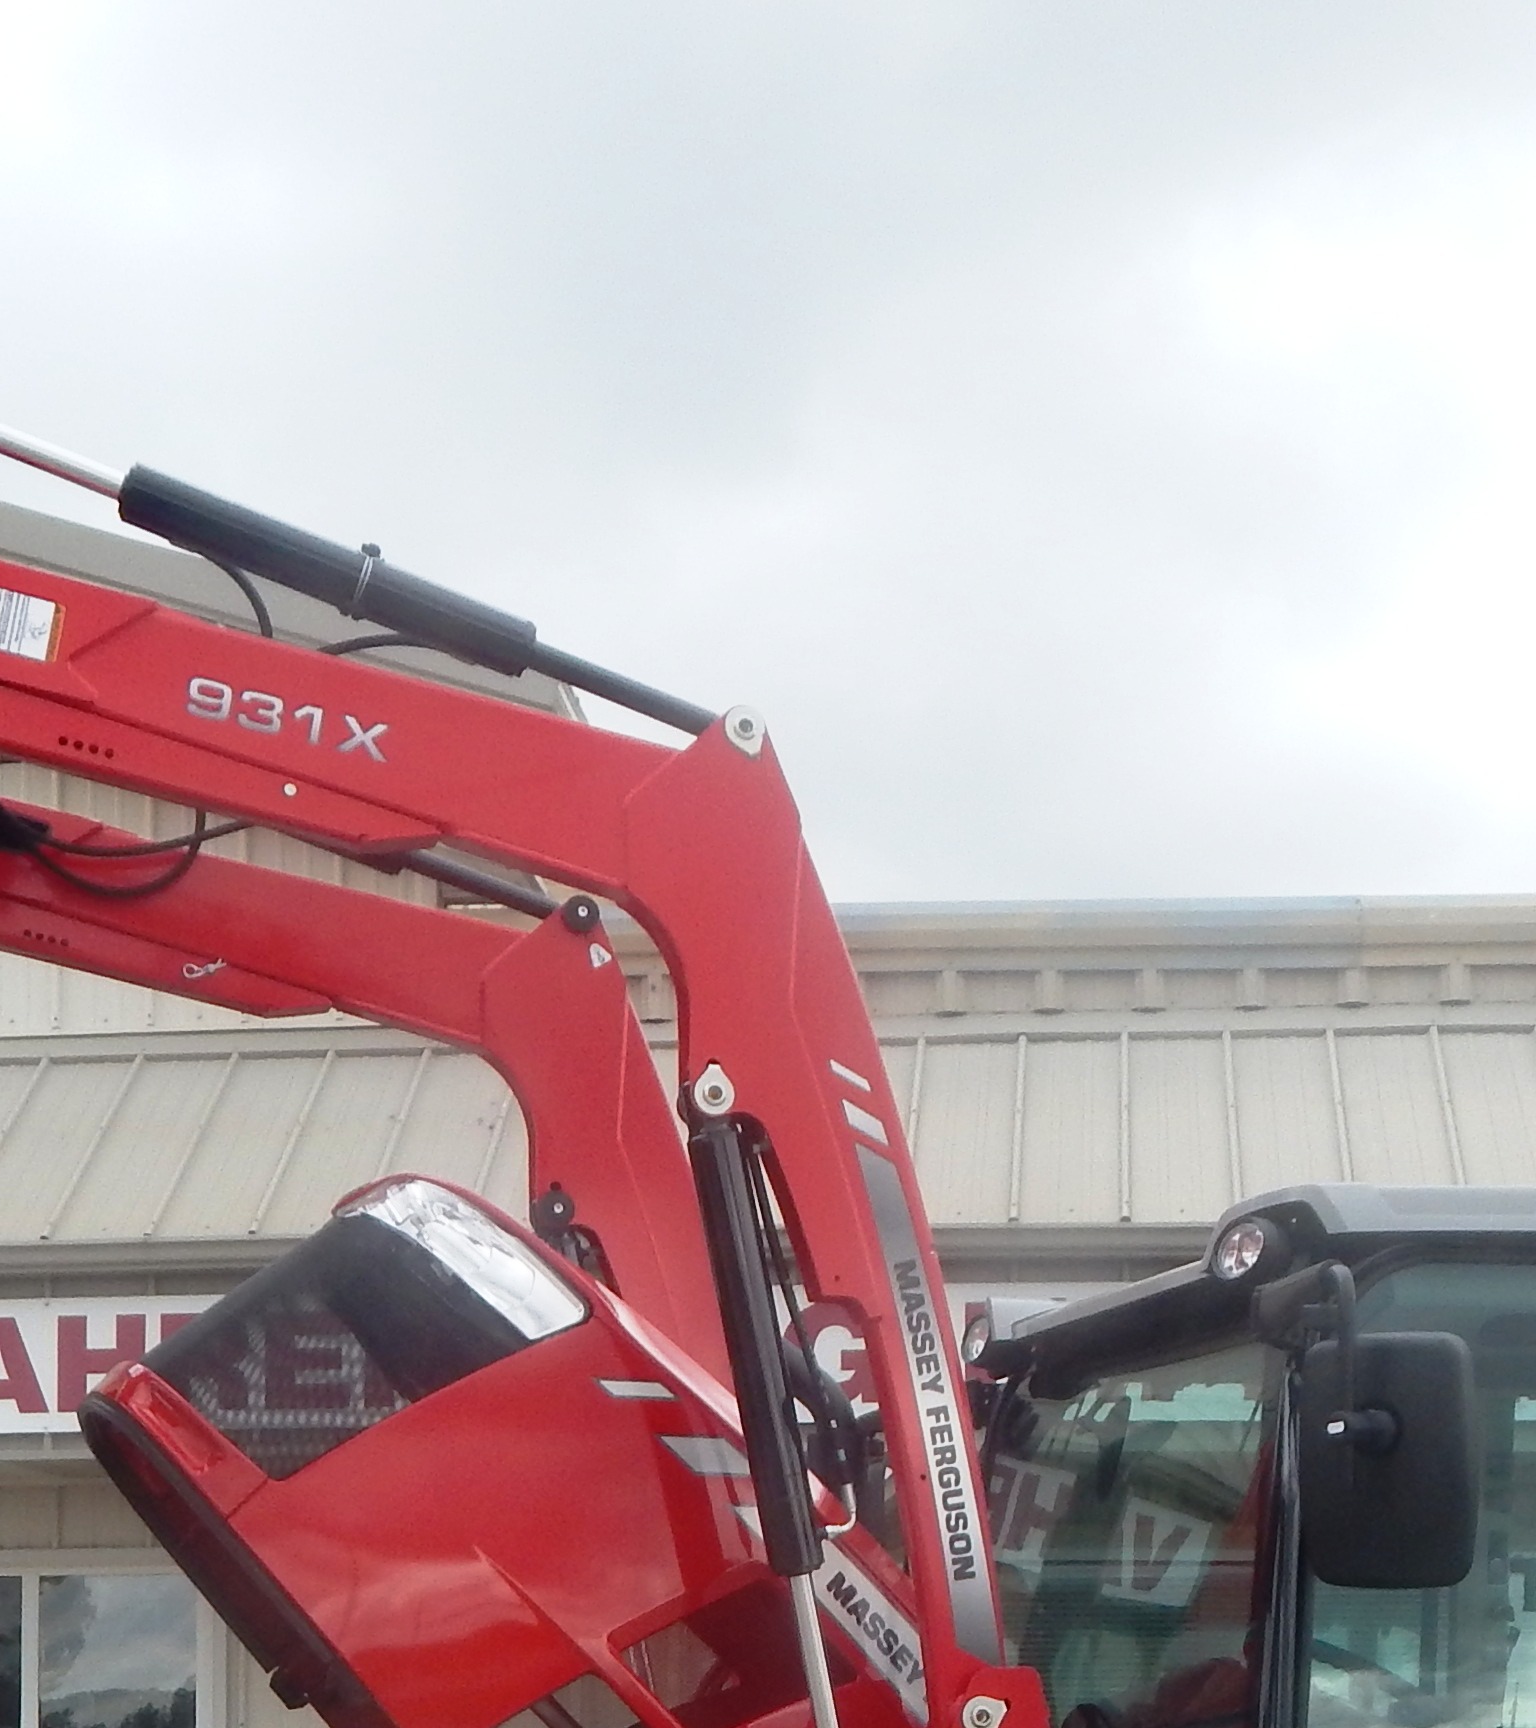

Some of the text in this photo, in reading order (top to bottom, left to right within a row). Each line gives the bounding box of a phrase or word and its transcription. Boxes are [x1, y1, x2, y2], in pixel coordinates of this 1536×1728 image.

[186, 675, 388, 764] 931X
[894, 1258, 976, 1582] MASSEY FERGUSON
[826, 1570, 924, 1685] MASSEY
